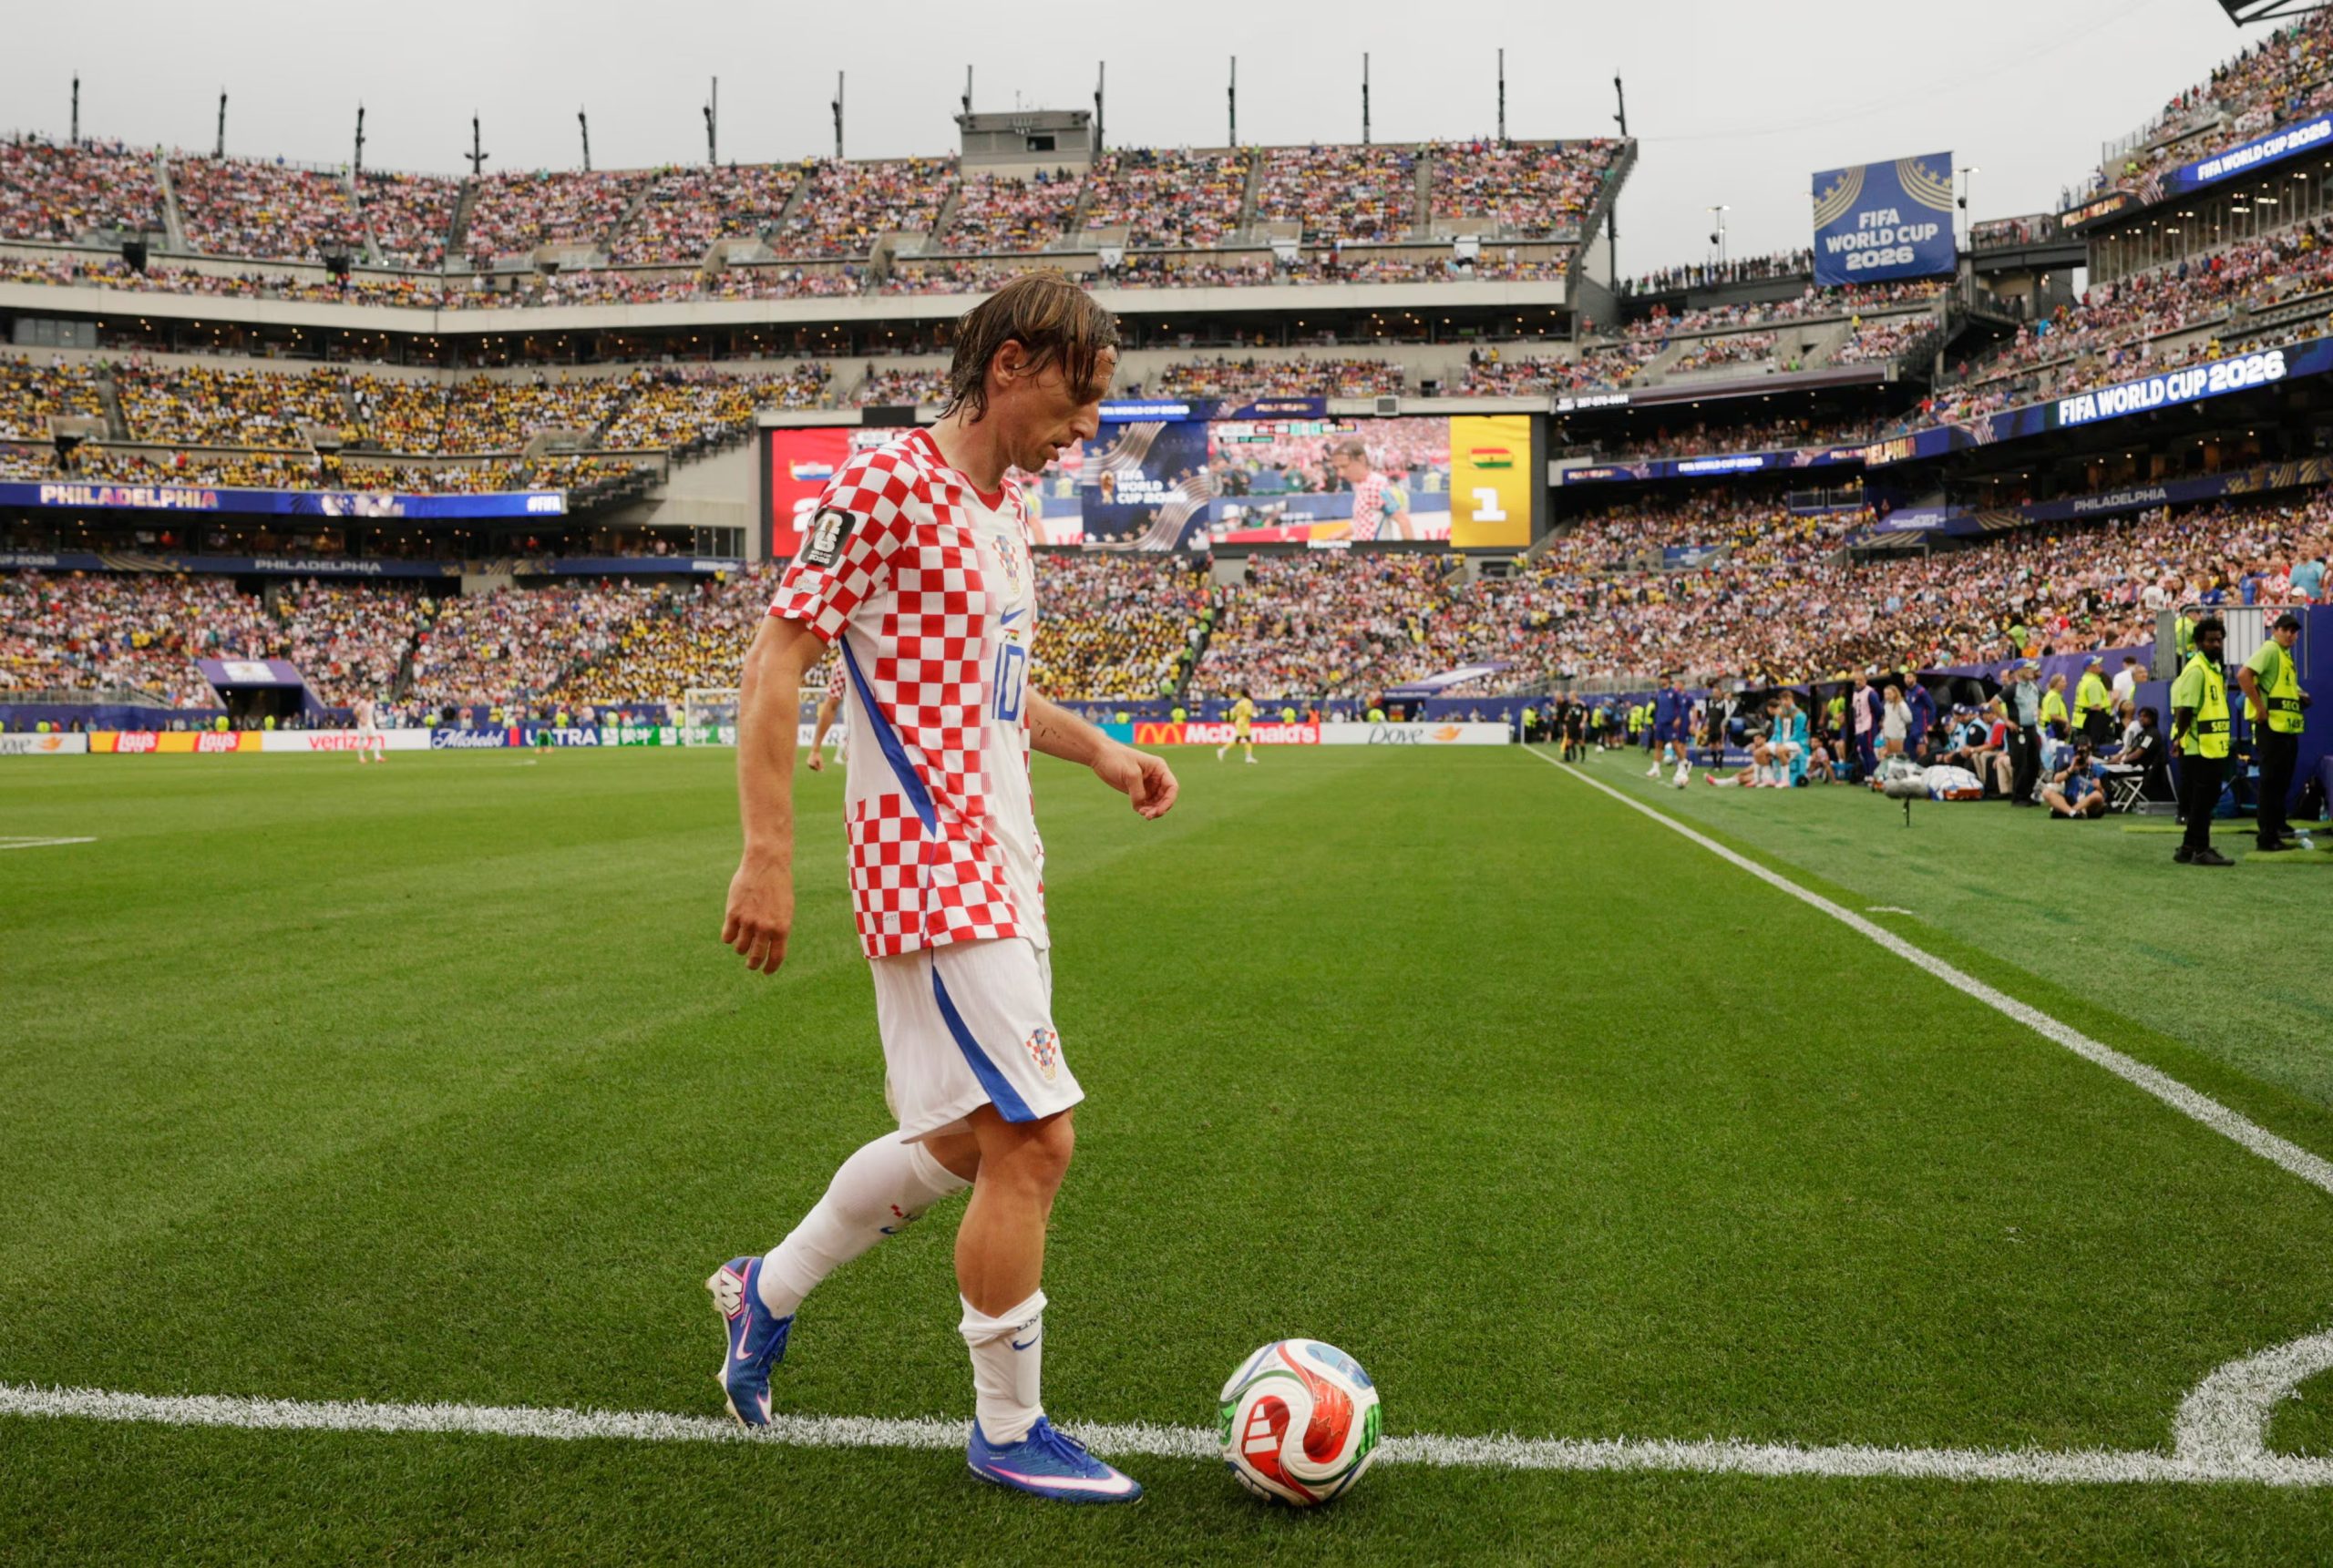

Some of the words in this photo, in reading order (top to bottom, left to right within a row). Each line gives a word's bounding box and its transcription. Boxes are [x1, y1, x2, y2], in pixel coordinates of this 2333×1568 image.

[2197, 161, 2224, 180] FIFA
[2222, 147, 2264, 173] WORLD
[2263, 136, 2289, 158] CUP
[2287, 120, 2332, 149] 2026
[1859, 208, 1900, 229] FIFA
[1825, 229, 1895, 253] WORLD
[1896, 223, 1939, 244] CUP
[1845, 246, 1915, 271] 2026
[2059, 395, 2097, 425] FIFA
[2097, 378, 2165, 415] WORLD
[2166, 368, 2207, 401] CUP
[2209, 350, 2286, 393] 2026
[1117, 470, 1145, 481] FIFA
[40, 485, 220, 508] PHILADELPHIA
[1116, 481, 1164, 492] WORLD
[1116, 493, 1143, 504] CUP
[1472, 488, 1506, 521] 1
[2073, 487, 2167, 512] PHILADELPHIA
[0, 555, 15, 565] UP
[254, 559, 382, 573] PHILADELPHIA
[992, 642, 1026, 722] 10
[118, 731, 156, 752] Lay's
[198, 731, 237, 752] Lay's
[432, 729, 505, 749] Michelob
[525, 728, 598, 745] UTRA
[1186, 723, 1317, 743] McDnald's
[1368, 725, 1424, 744] Dove
[0, 739, 32, 753] ove
